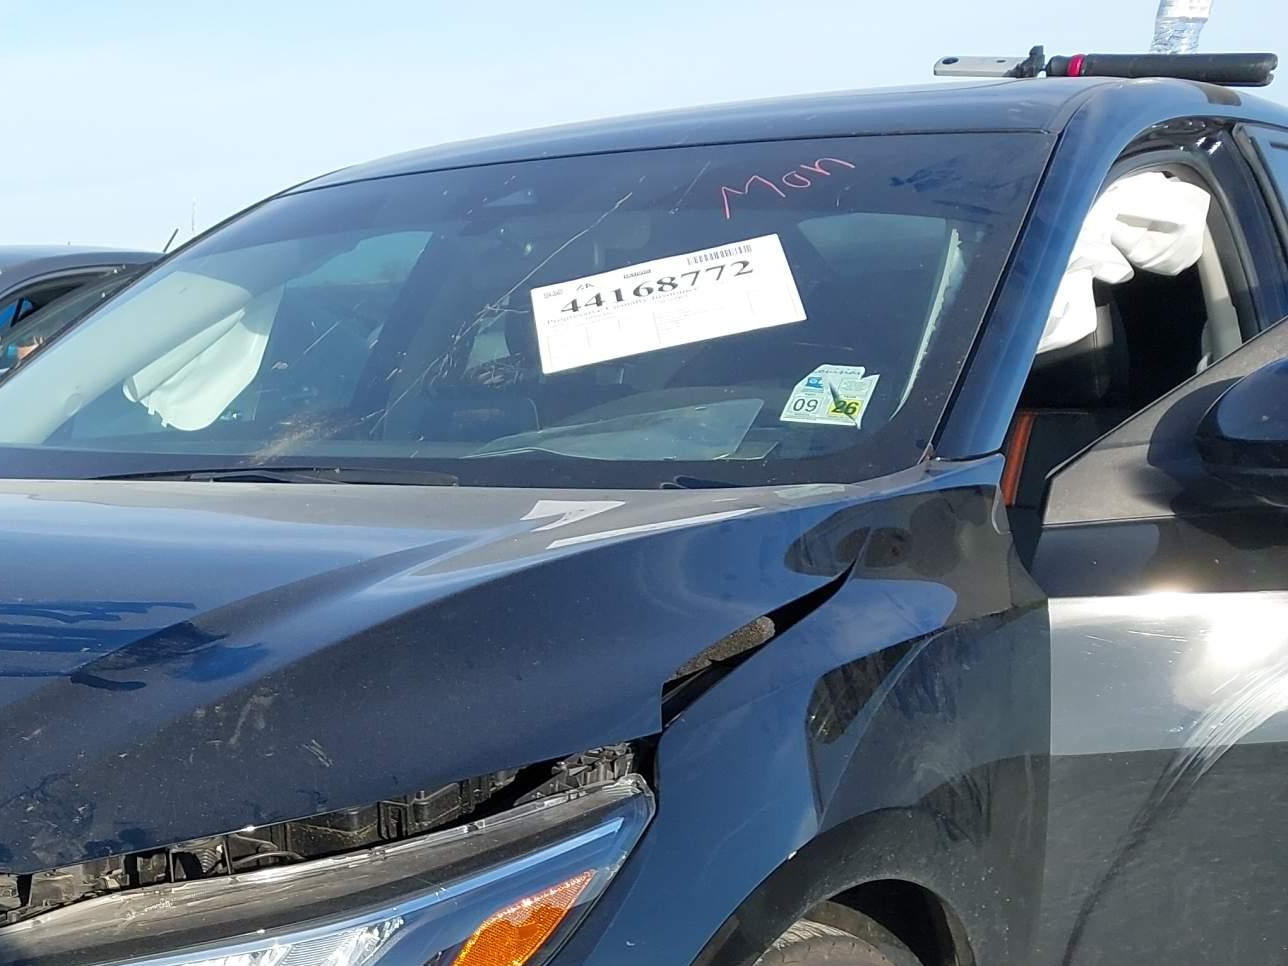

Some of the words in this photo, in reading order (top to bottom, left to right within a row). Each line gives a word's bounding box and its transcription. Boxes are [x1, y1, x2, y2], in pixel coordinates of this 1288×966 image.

[721, 157, 856, 220] Mon
[560, 259, 754, 314] 44168772
[792, 398, 819, 413] 09
[831, 400, 860, 416] 26
